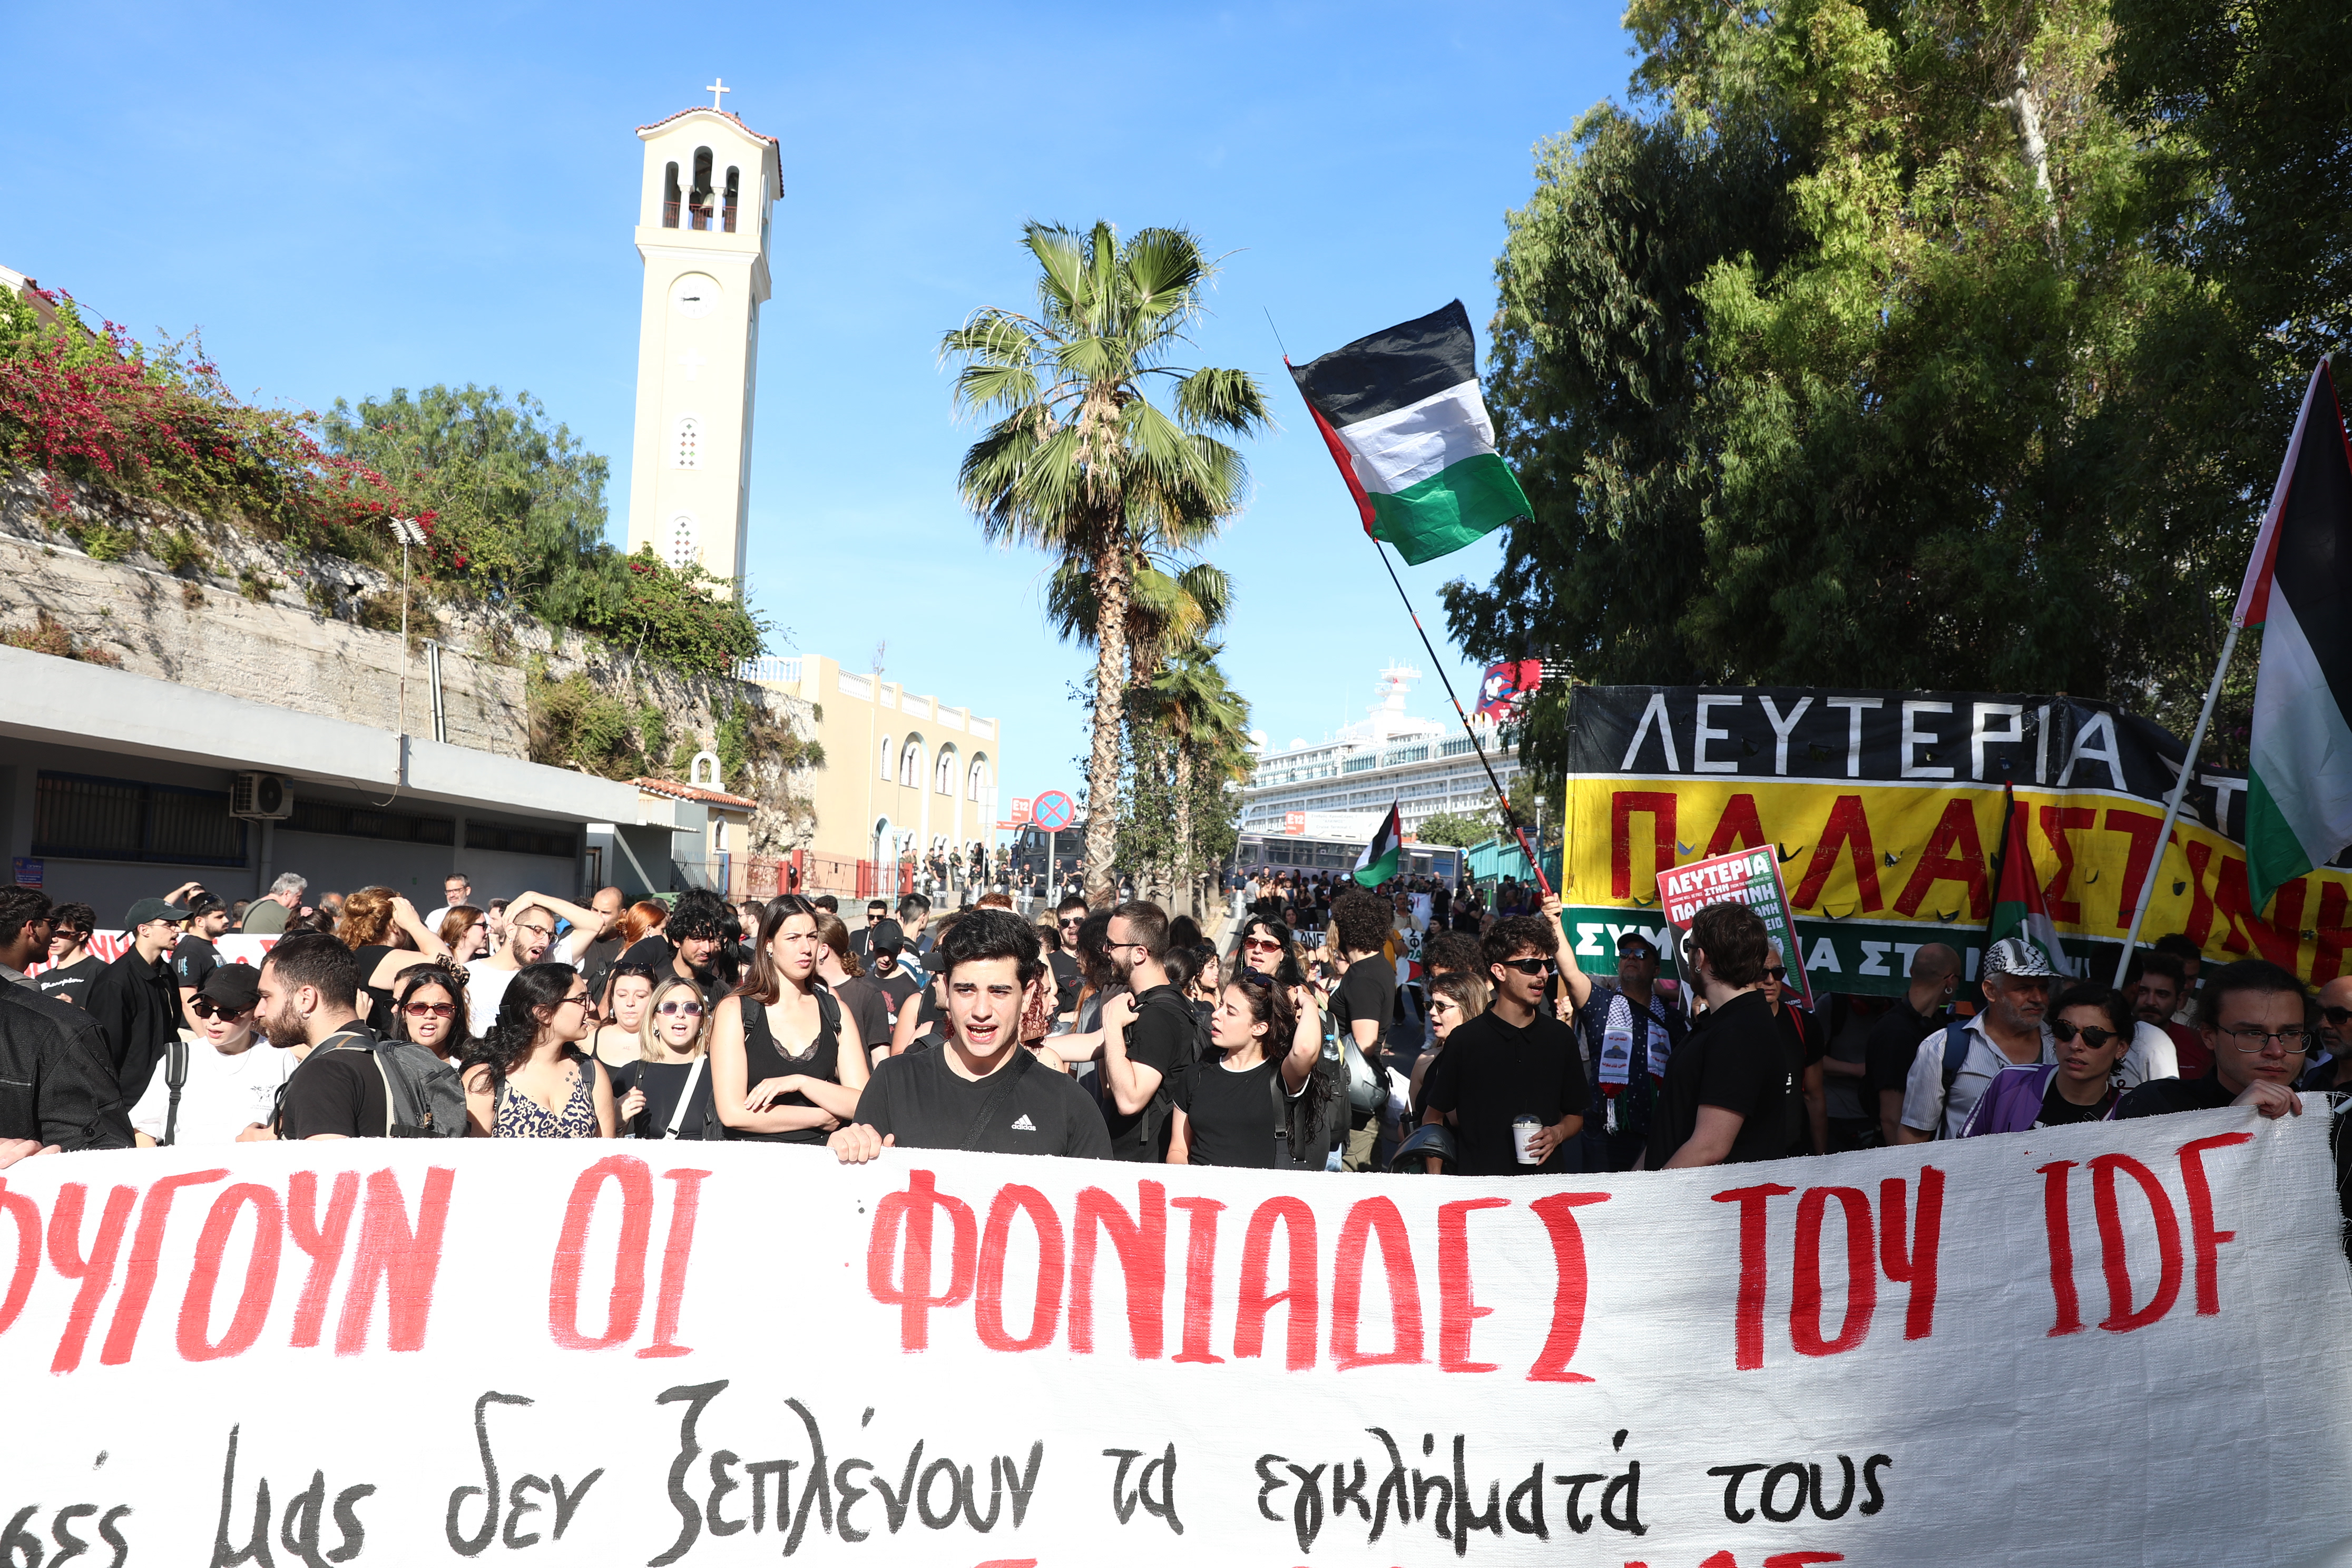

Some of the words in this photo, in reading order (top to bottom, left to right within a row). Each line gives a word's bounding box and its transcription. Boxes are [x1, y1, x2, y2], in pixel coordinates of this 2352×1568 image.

[1620, 692, 2129, 791] ΛΕΥΤΕΡΙΑ
[1013, 800, 1028, 811] E12
[1287, 813, 1304, 825] E12
[1668, 854, 1770, 896] ΛΕΥΤΕΡΙΑ
[1704, 884, 1730, 897] ΣΤΗΝ
[548, 1154, 713, 1359] ΟΙ
[867, 1169, 1612, 1384] ΦΟΝΙΑΔΕΣ
[1711, 1165, 1946, 1371] ΤΟΥ
[2034, 1132, 2256, 1338] IDF
[210, 1422, 377, 1568] μας
[447, 1391, 606, 1557] δεν
[645, 1379, 1043, 1568] ξεπλένουν
[1101, 1440, 1184, 1535] τα
[1255, 1427, 1650, 1557] εγκλήματά
[1707, 1453, 1893, 1524] τους
